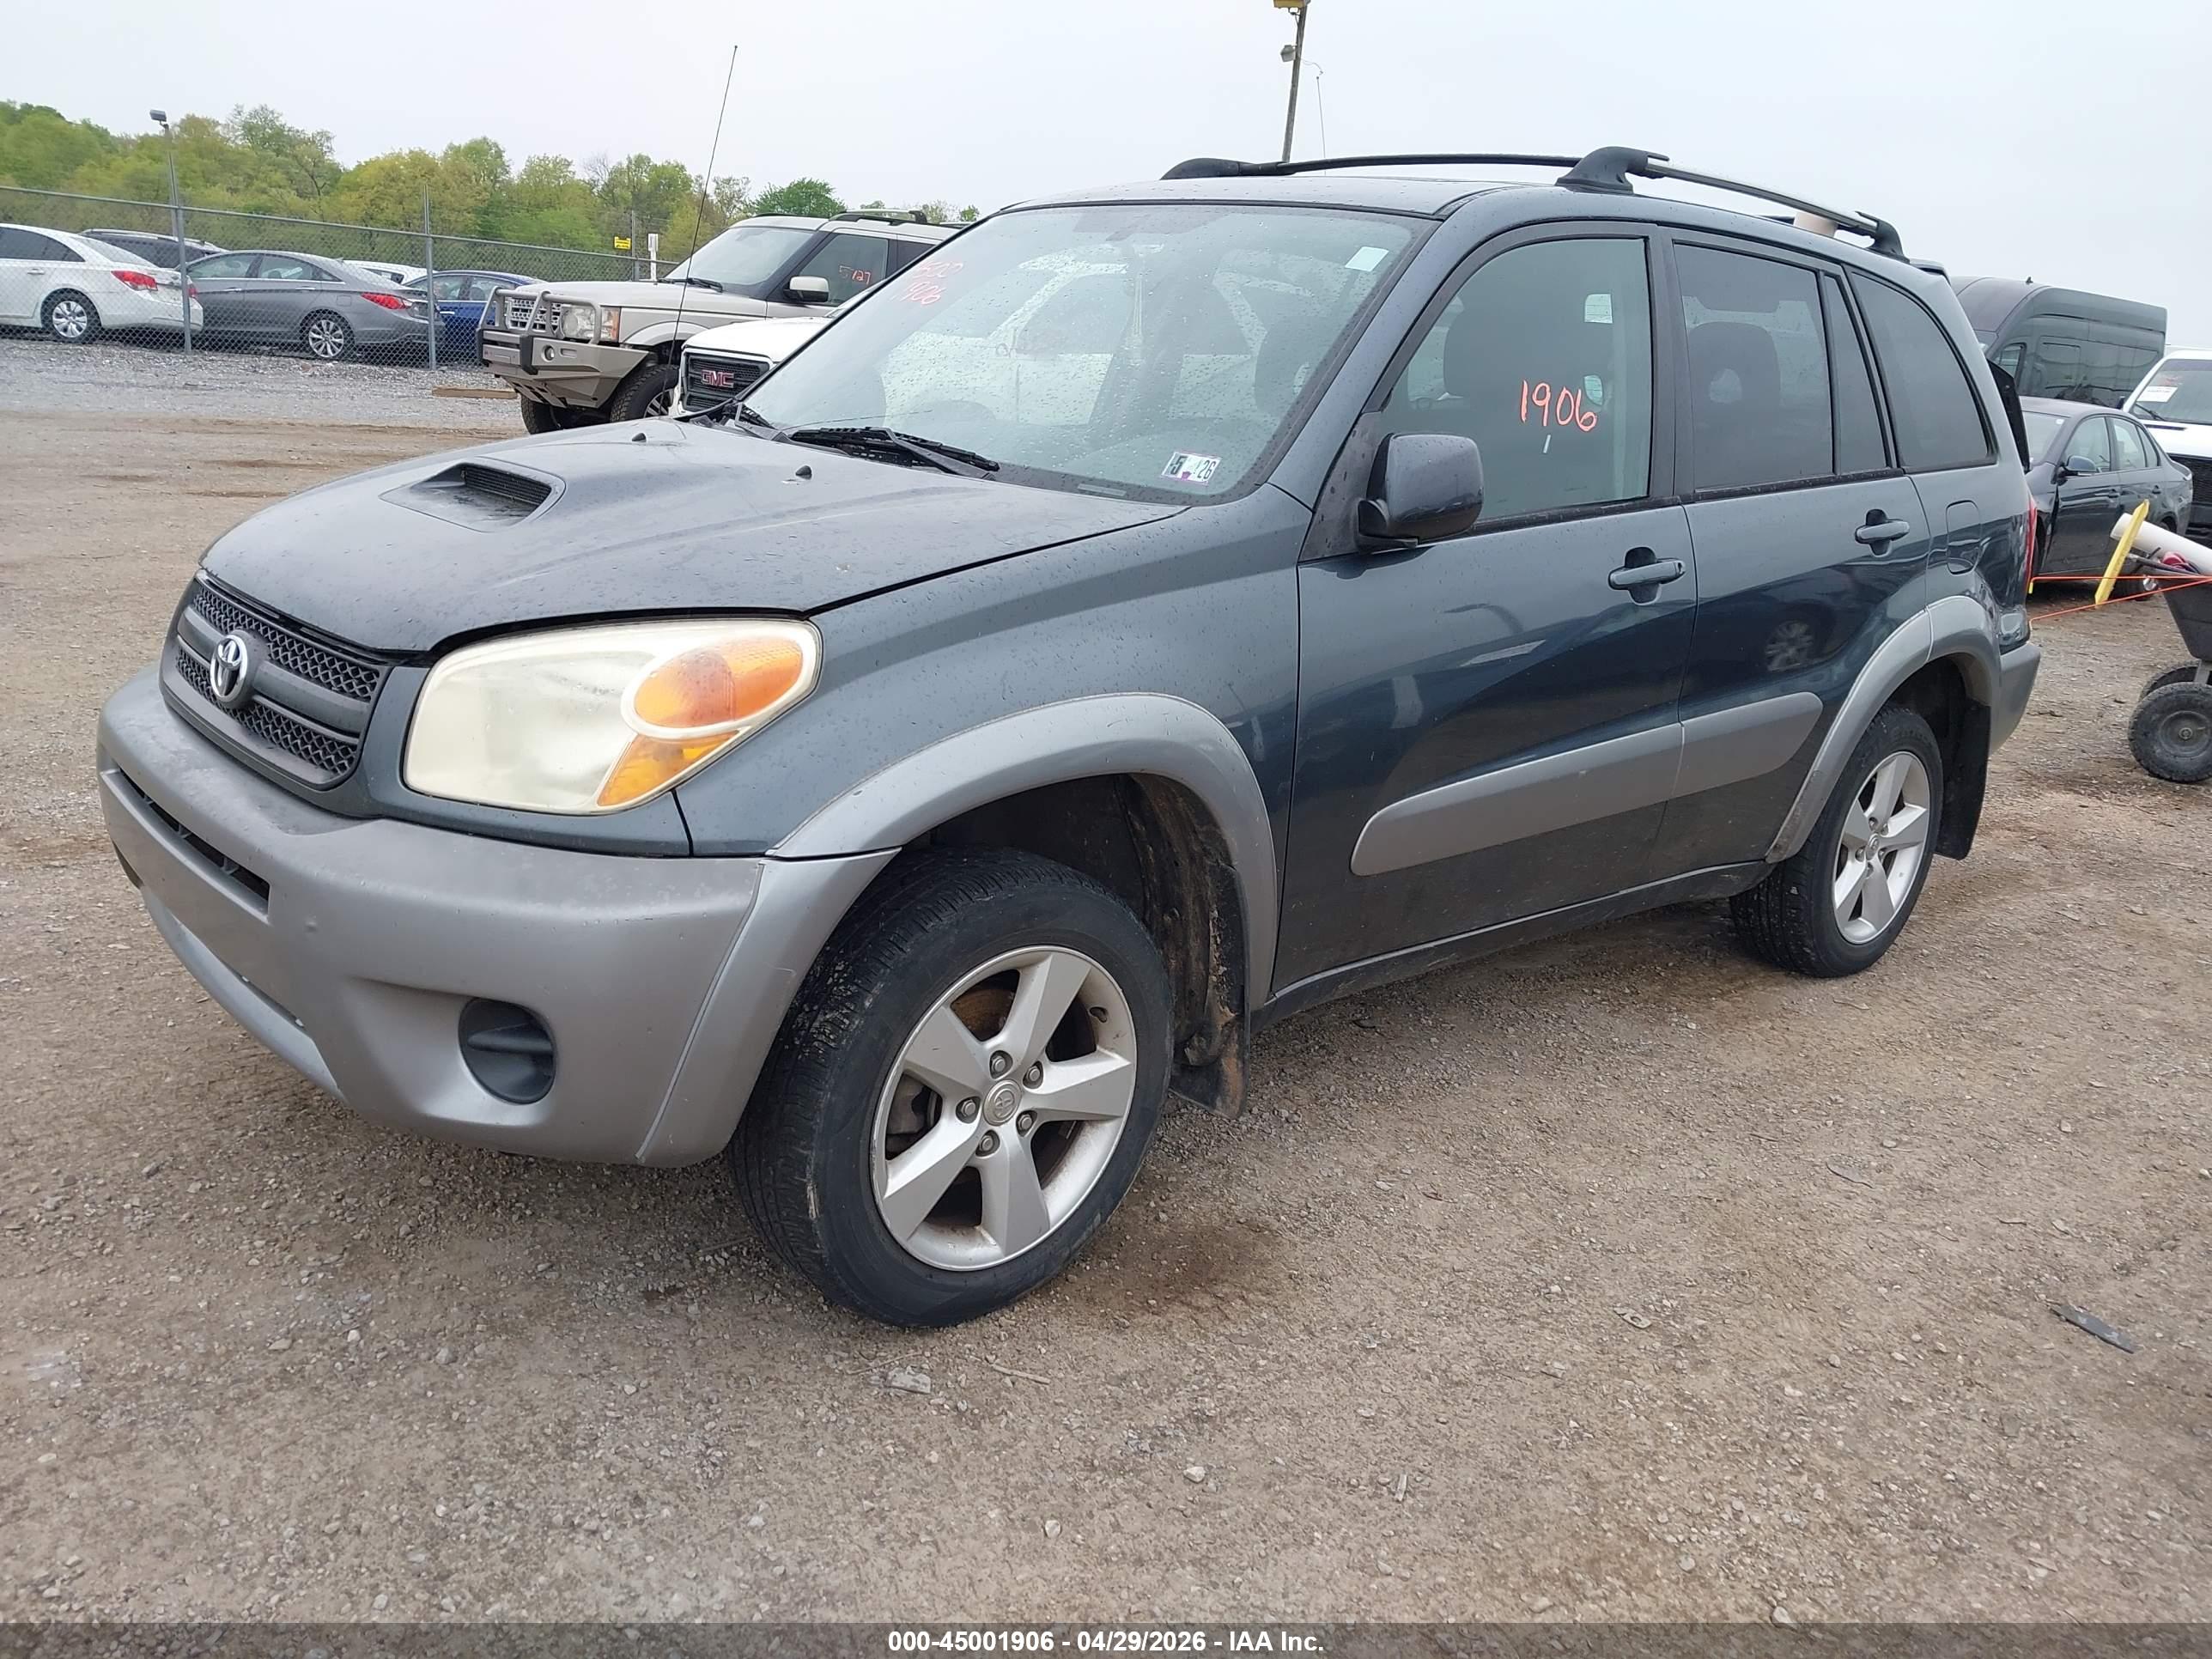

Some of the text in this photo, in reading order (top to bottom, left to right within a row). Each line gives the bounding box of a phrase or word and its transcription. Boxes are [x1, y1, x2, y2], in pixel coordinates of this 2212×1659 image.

[701, 369, 734, 388] GMC
[1521, 380, 1598, 432] 1906
[1197, 459, 1217, 479] 26
